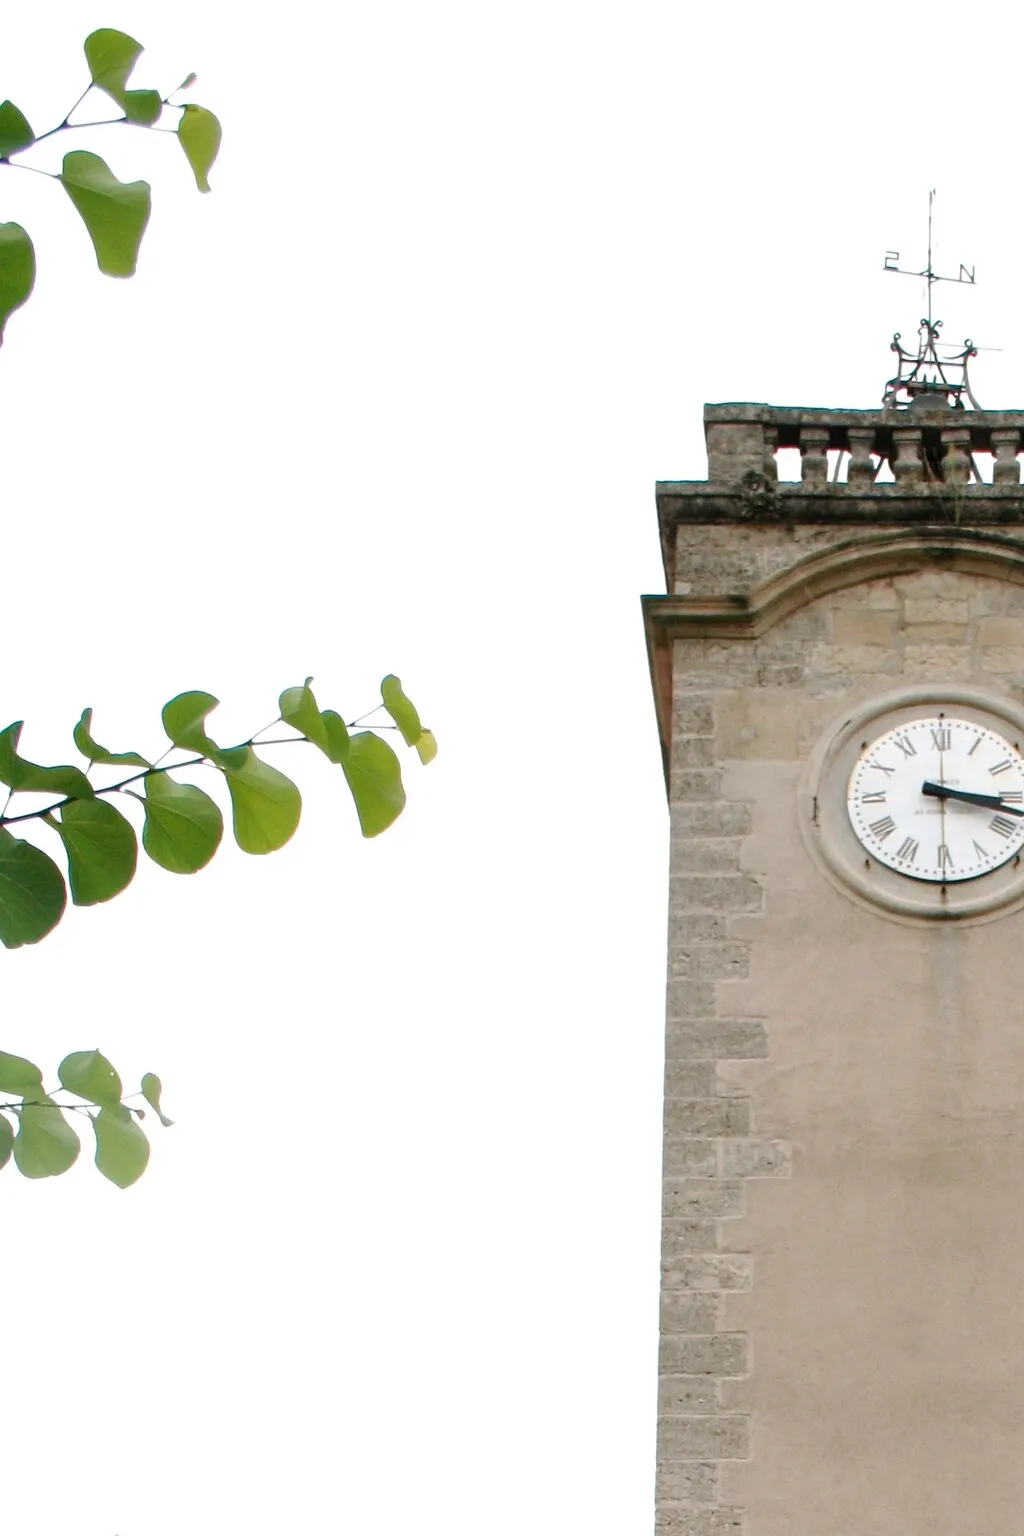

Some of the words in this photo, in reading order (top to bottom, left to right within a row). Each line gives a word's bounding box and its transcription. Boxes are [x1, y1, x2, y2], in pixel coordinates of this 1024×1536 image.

[960, 264, 975, 283] N
[894, 736, 918, 760] XI
[931, 729, 951, 751] XII
[967, 737, 982, 756] I
[870, 760, 895, 777] X
[988, 759, 1014, 776] II
[862, 791, 886, 804] IX
[999, 791, 1023, 803] III
[869, 816, 898, 842] VIII
[896, 836, 920, 864] VII
[938, 844, 954, 868] VI
[972, 839, 989, 861] V
